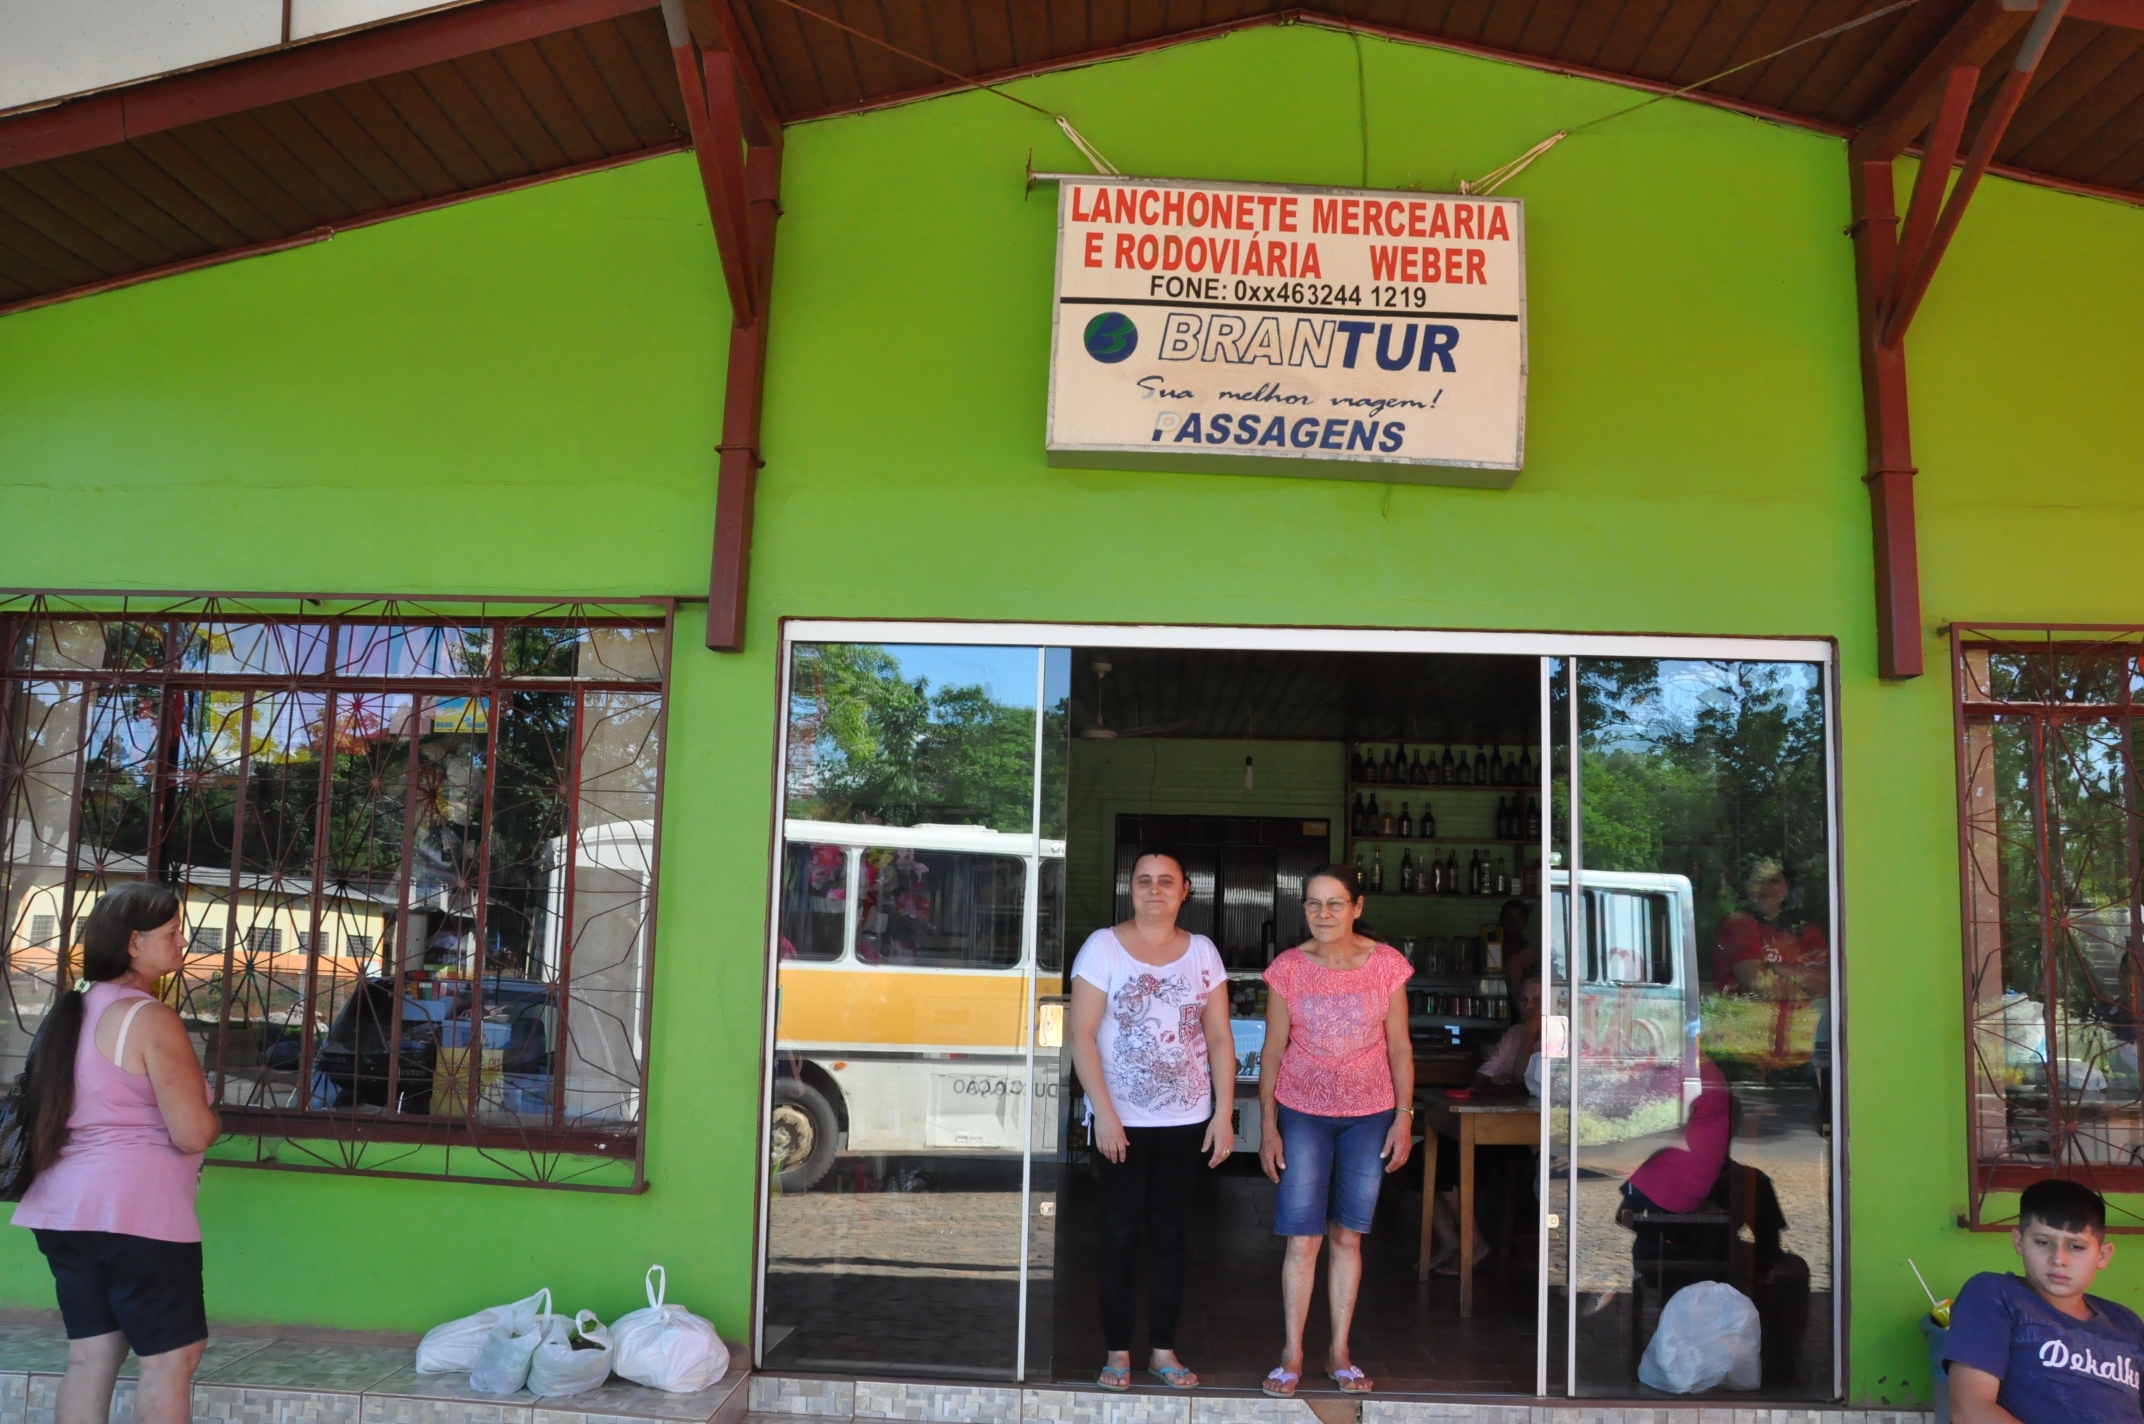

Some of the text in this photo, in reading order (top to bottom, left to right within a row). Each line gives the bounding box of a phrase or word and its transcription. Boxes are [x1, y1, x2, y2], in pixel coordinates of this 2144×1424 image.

[1072, 186, 1511, 242] LANCHONETE MERCEARIA
[1083, 230, 1488, 286] E RODOVIÁRIA WEBER
[1150, 275, 1227, 301] FONE:
[1370, 286, 1427, 309] 1219
[1158, 312, 1461, 374] BRANTUR
[1136, 375, 1195, 399] Sua
[1218, 382, 1315, 405] melhor
[1151, 410, 1406, 453] PASSAGENS
